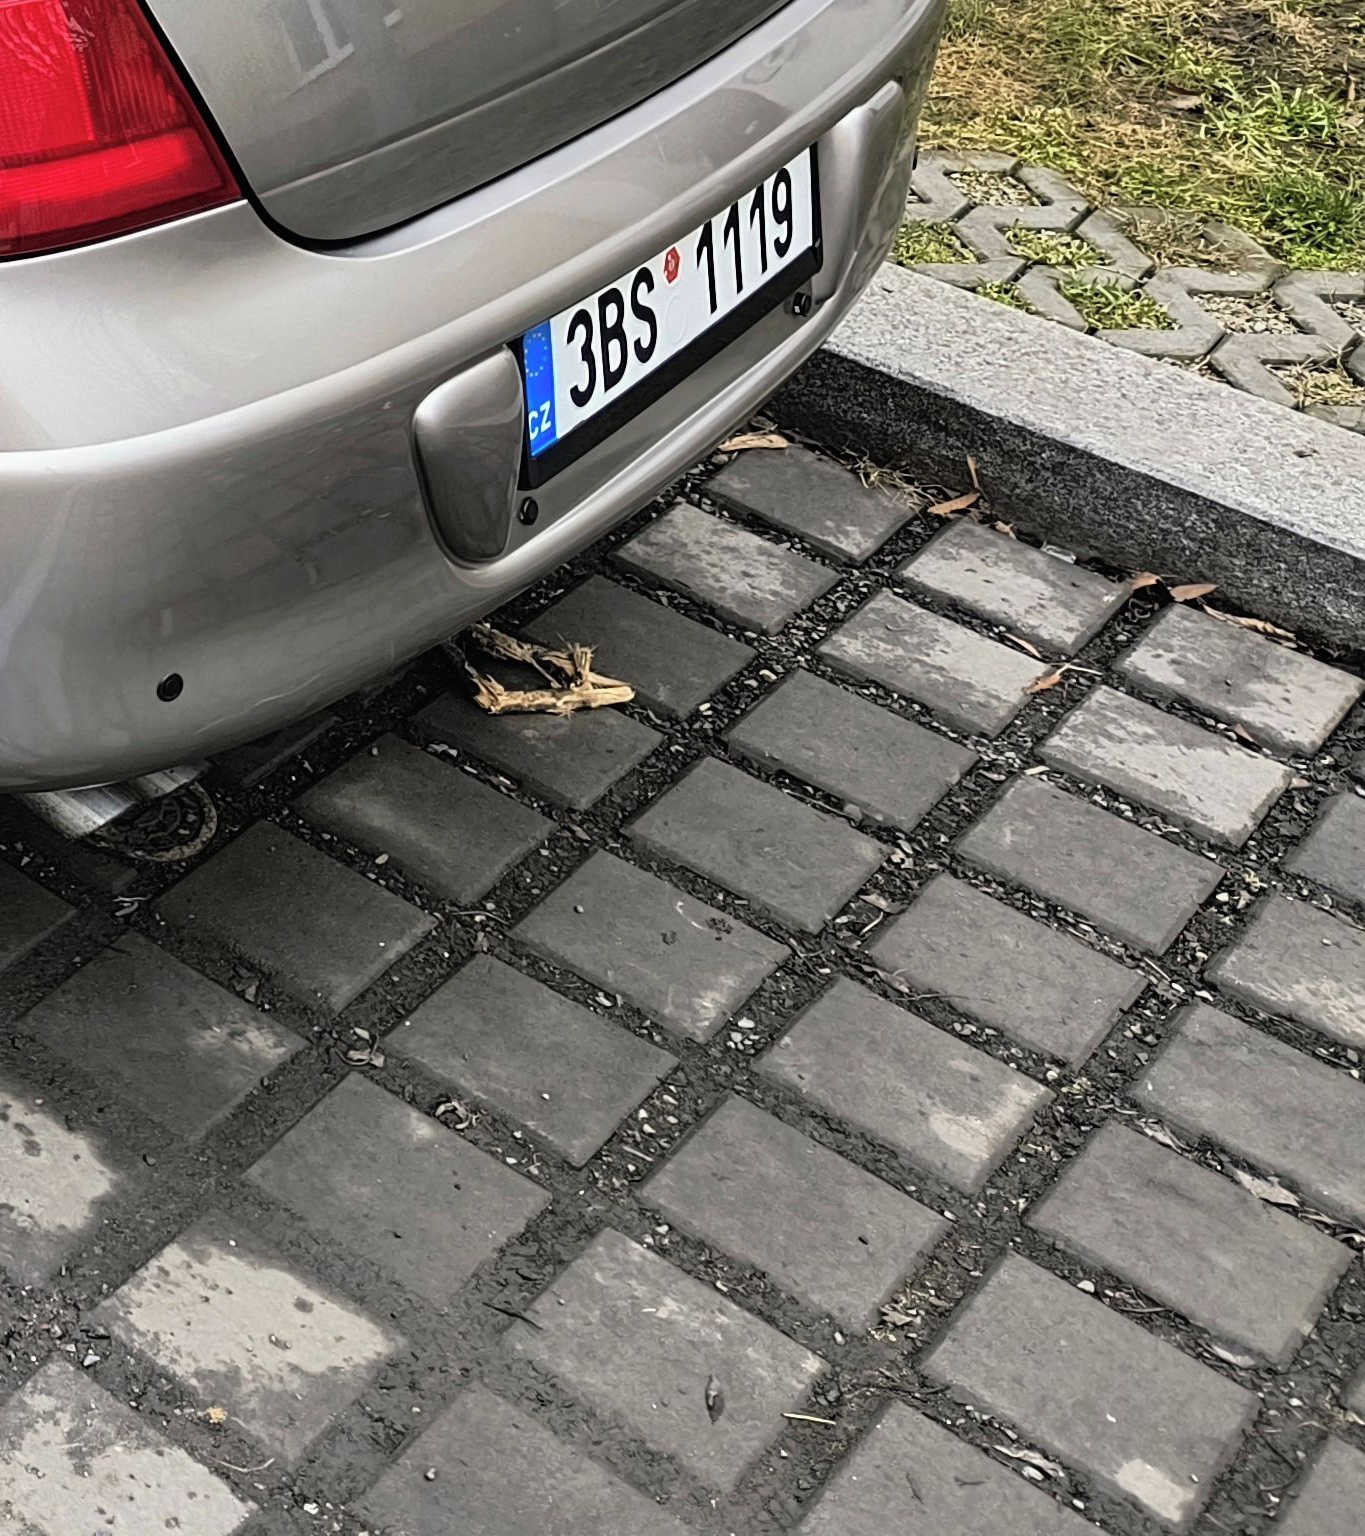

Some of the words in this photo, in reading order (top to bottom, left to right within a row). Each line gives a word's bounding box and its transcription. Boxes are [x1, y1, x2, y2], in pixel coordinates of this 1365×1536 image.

[528, 400, 552, 440] CZ
[566, 266, 658, 408] 3BS
[696, 167, 793, 315] 1119
